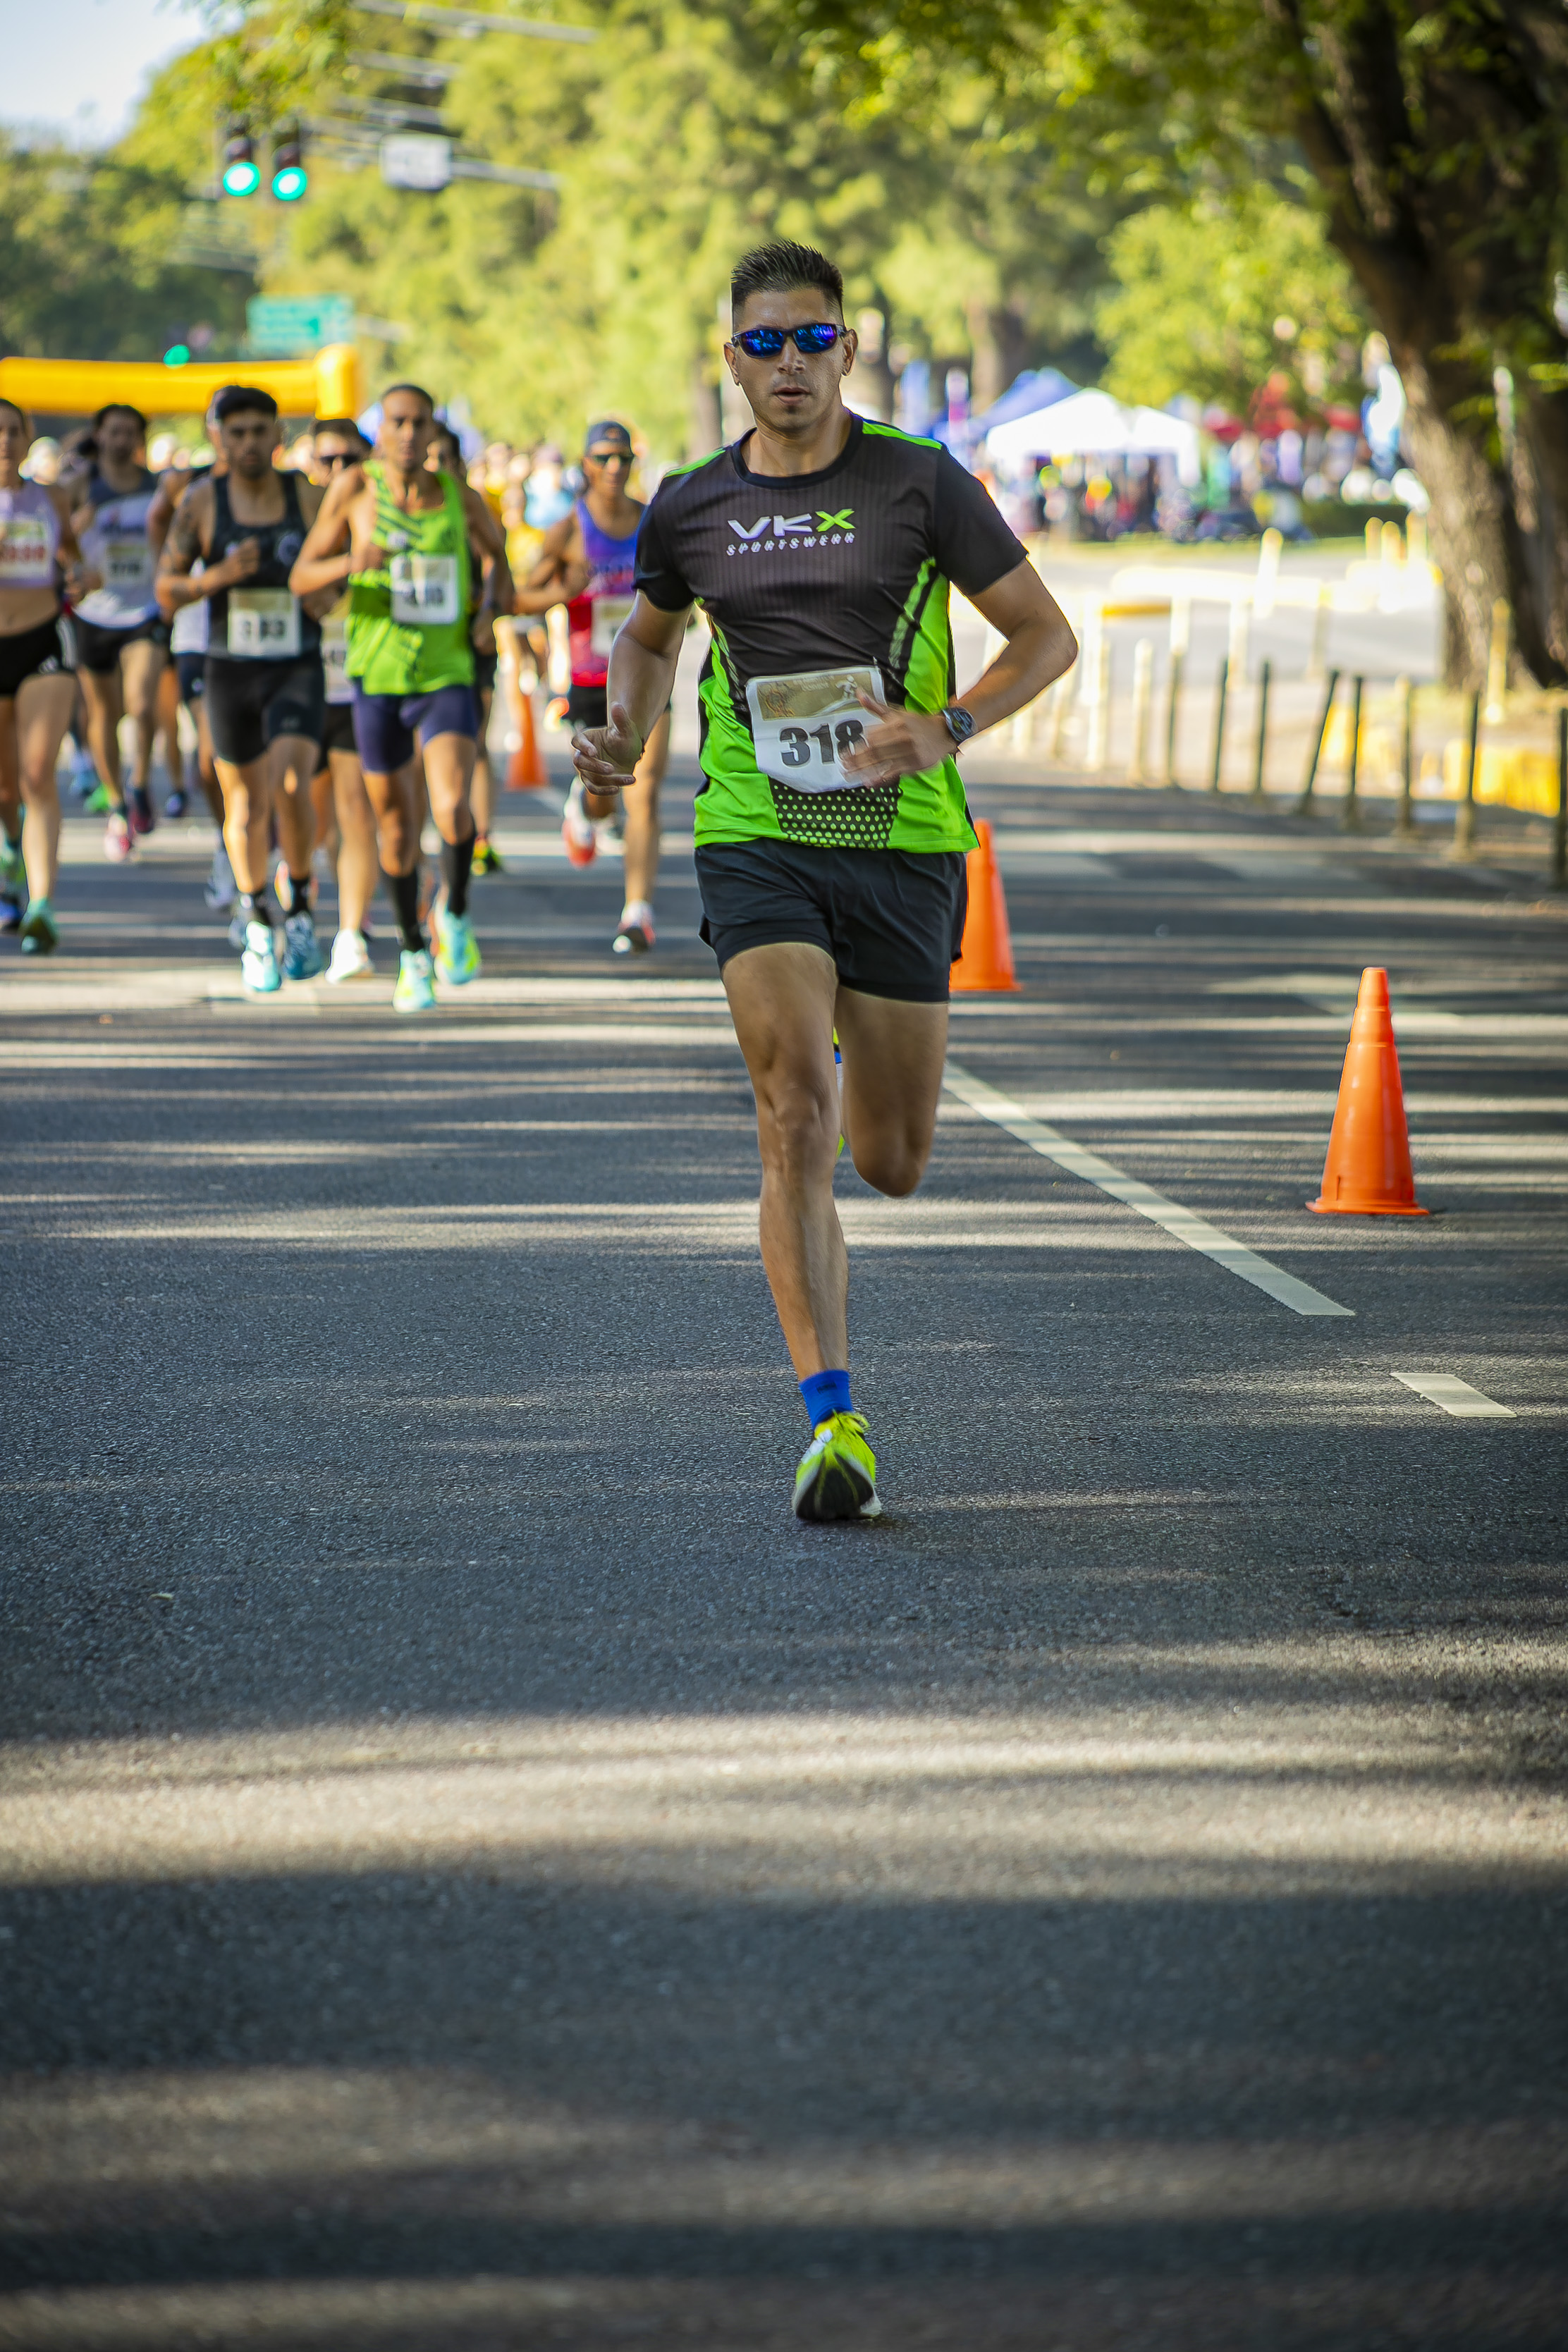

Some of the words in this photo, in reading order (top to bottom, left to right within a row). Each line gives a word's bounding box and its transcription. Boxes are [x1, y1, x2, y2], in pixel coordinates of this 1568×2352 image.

[728, 508, 856, 539] VKX
[726, 532, 855, 556] SPORTSWEAR
[779, 719, 869, 767] 318
